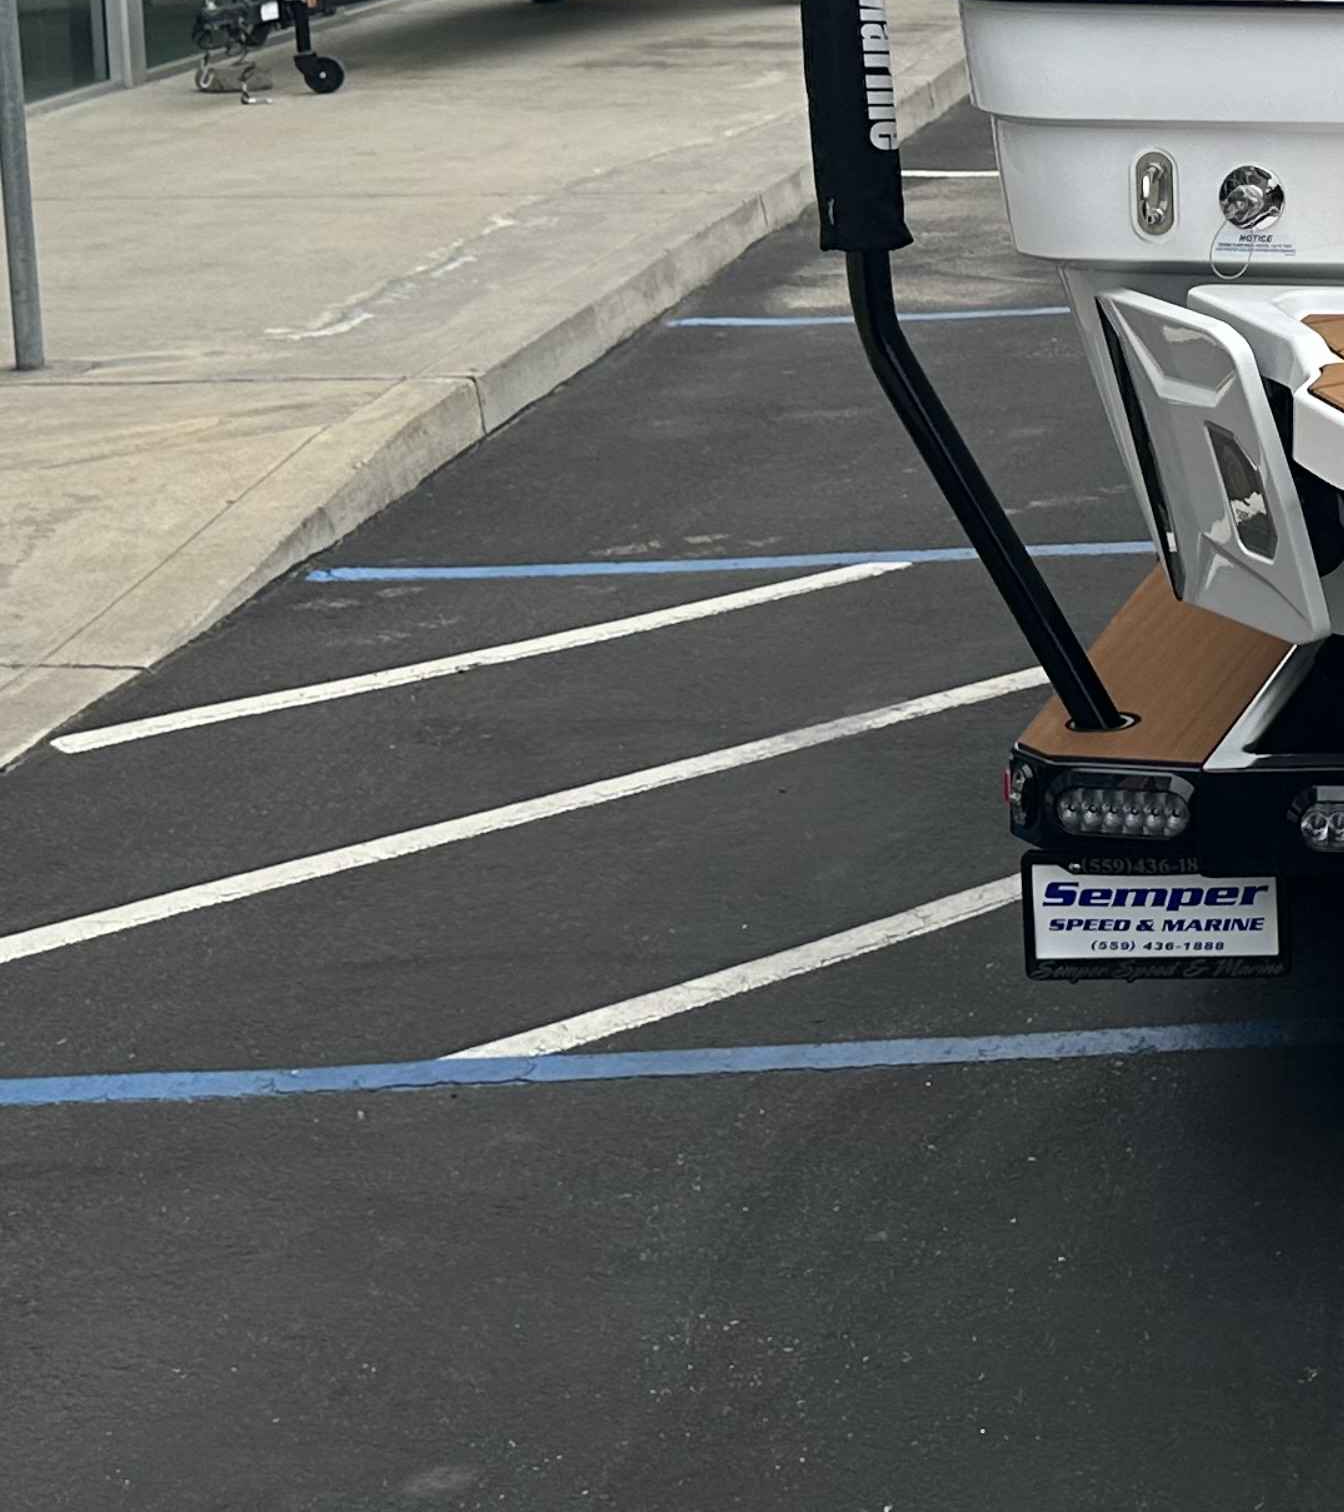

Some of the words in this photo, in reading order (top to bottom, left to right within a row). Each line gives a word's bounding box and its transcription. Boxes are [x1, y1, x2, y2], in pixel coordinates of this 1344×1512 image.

[1239, 233, 1273, 243] NOTICE
[1042, 881, 1269, 912] Semper
[1048, 918, 1132, 932] SPEED
[1135, 918, 1155, 932] &
[1162, 917, 1265, 932] MARINE
[1091, 940, 1136, 953] (559)
